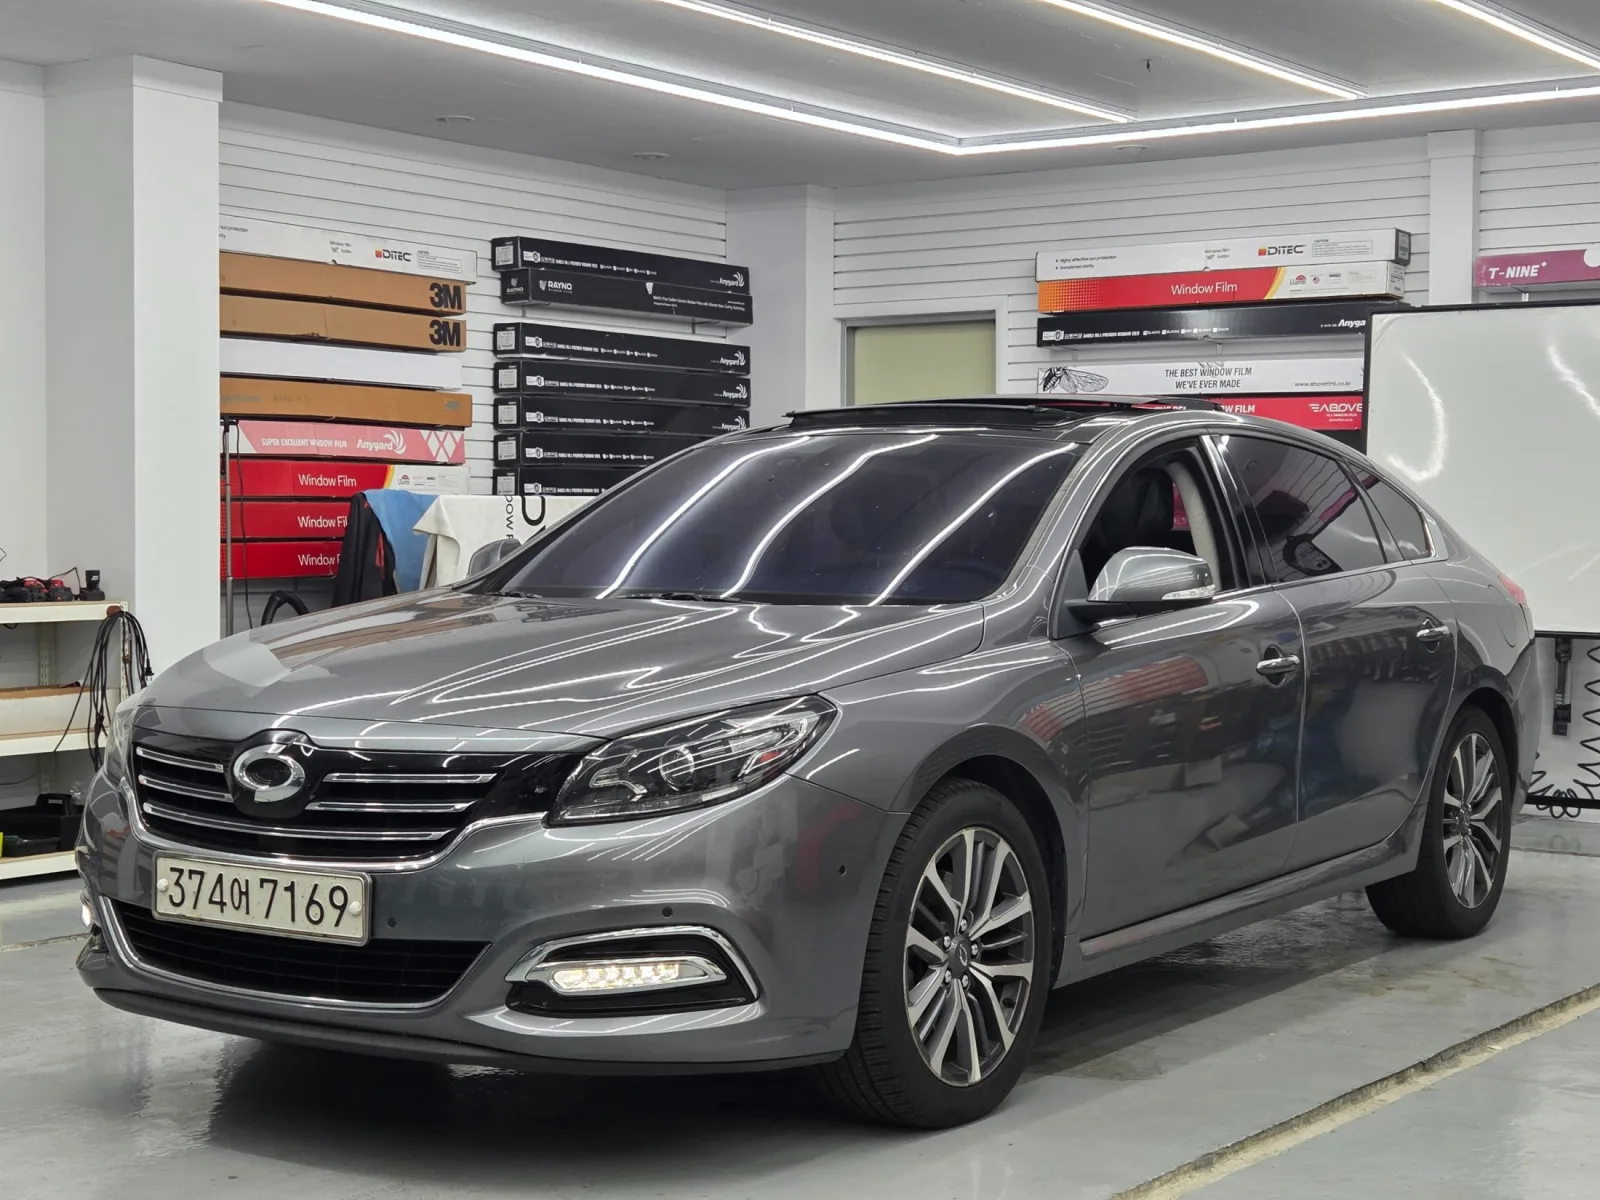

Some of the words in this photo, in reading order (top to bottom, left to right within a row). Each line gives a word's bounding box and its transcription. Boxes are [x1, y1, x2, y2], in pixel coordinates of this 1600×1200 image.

[547, 279, 573, 291] RAYNO
[1171, 283, 1212, 296] Window
[1215, 282, 1237, 293] Film
[430, 282, 462, 310] 3M
[429, 319, 461, 347] 3M
[1165, 369, 1179, 378] THE
[1180, 368, 1198, 377] BEST
[1200, 368, 1233, 377] WINDOW
[1234, 367, 1252, 376] FILM
[1175, 380, 1197, 389] WE'VE
[1199, 380, 1218, 389] EVER
[1219, 379, 1241, 388] MADE
[1234, 404, 1255, 413] FILM
[1319, 403, 1363, 412] ABOVE
[261, 438, 280, 446] SUPER
[281, 438, 309, 447] EXCELLENT
[310, 439, 333, 448] WINDOW
[334, 440, 347, 448] FILM
[356, 438, 393, 452] Anygard
[298, 474, 336, 487] Window
[337, 475, 357, 487] Film
[297, 516, 336, 528] Window
[297, 554, 335, 566] Window
[168, 867, 251, 916] 374어
[259, 877, 350, 928] 7169
